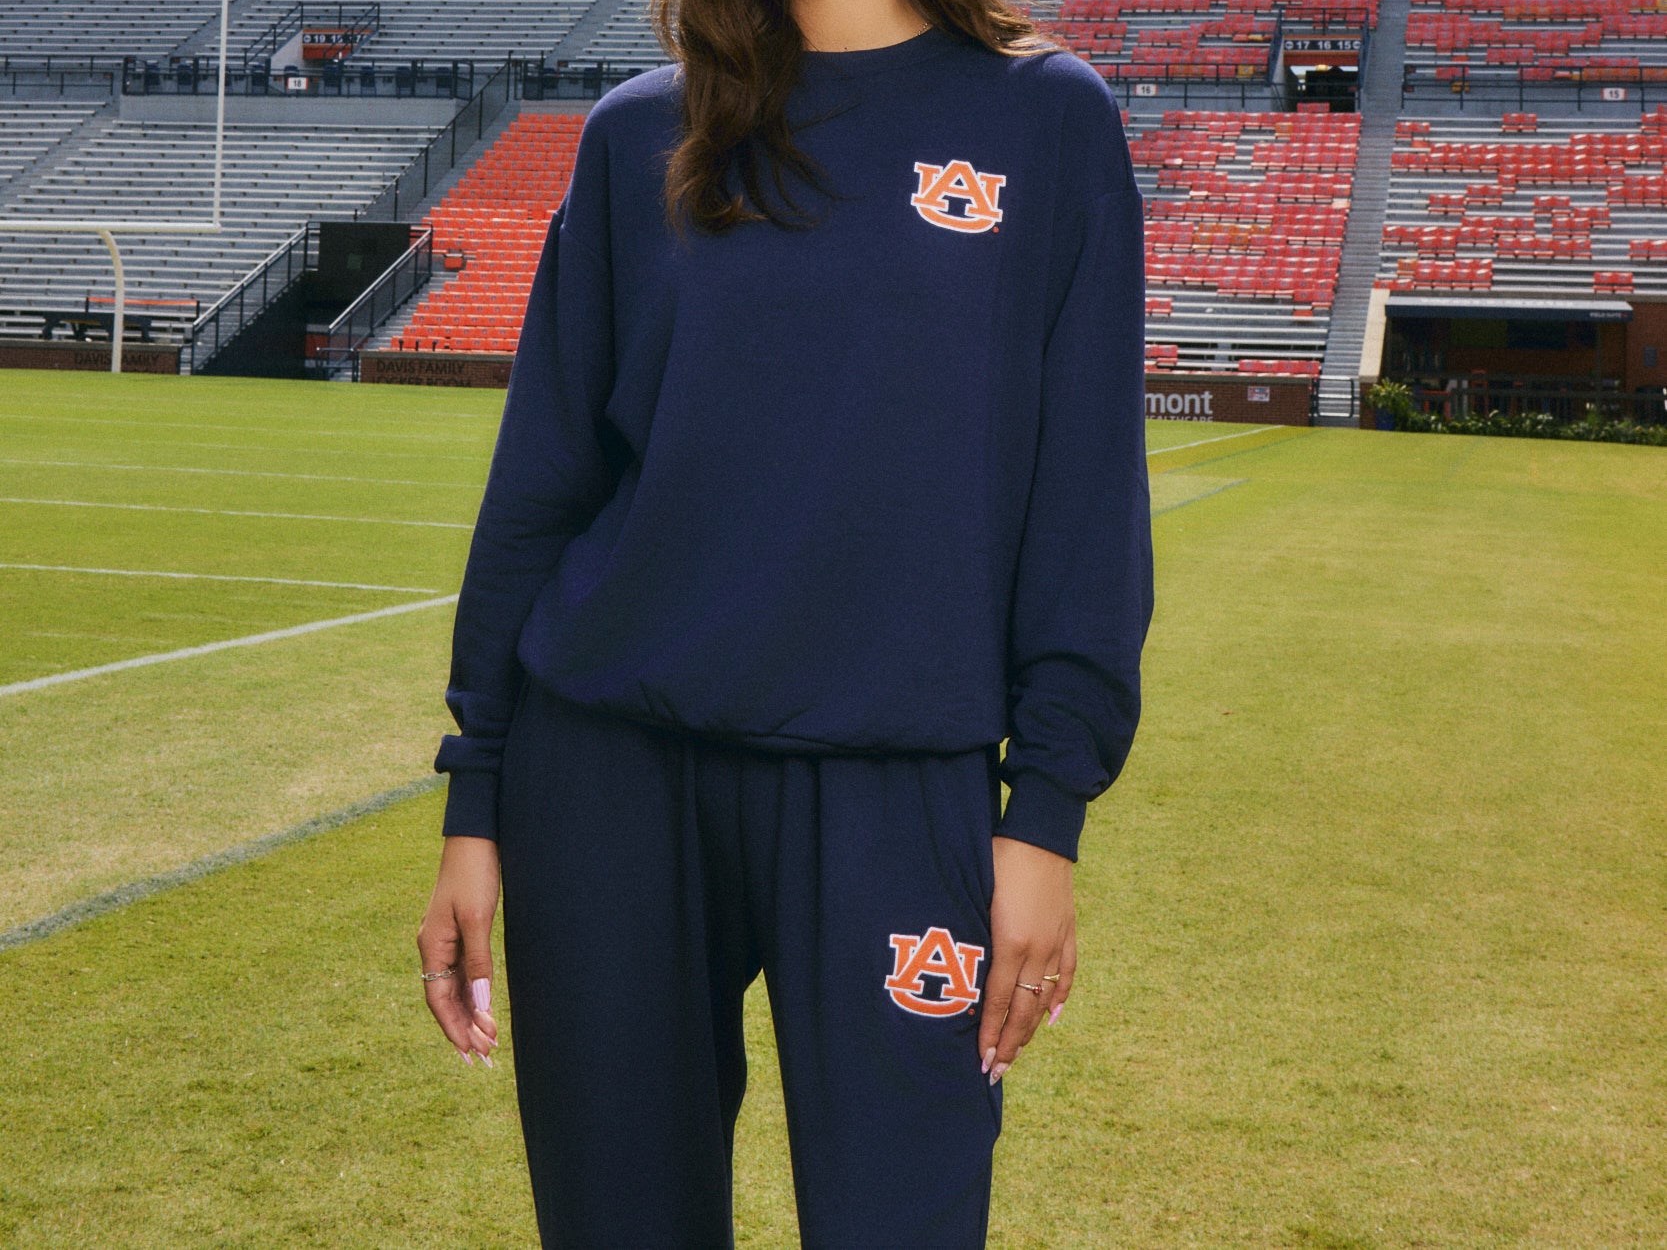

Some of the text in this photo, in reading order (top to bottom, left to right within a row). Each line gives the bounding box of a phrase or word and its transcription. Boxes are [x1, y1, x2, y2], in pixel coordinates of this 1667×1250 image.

[313, 35, 326, 43] 19
[1296, 40, 1351, 49] 17 16 15
[1141, 85, 1151, 94] 16
[1609, 90, 1620, 99] 15
[75, 351, 159, 367] DAVIS AMILY
[376, 359, 465, 375] DAVIS FAMILY
